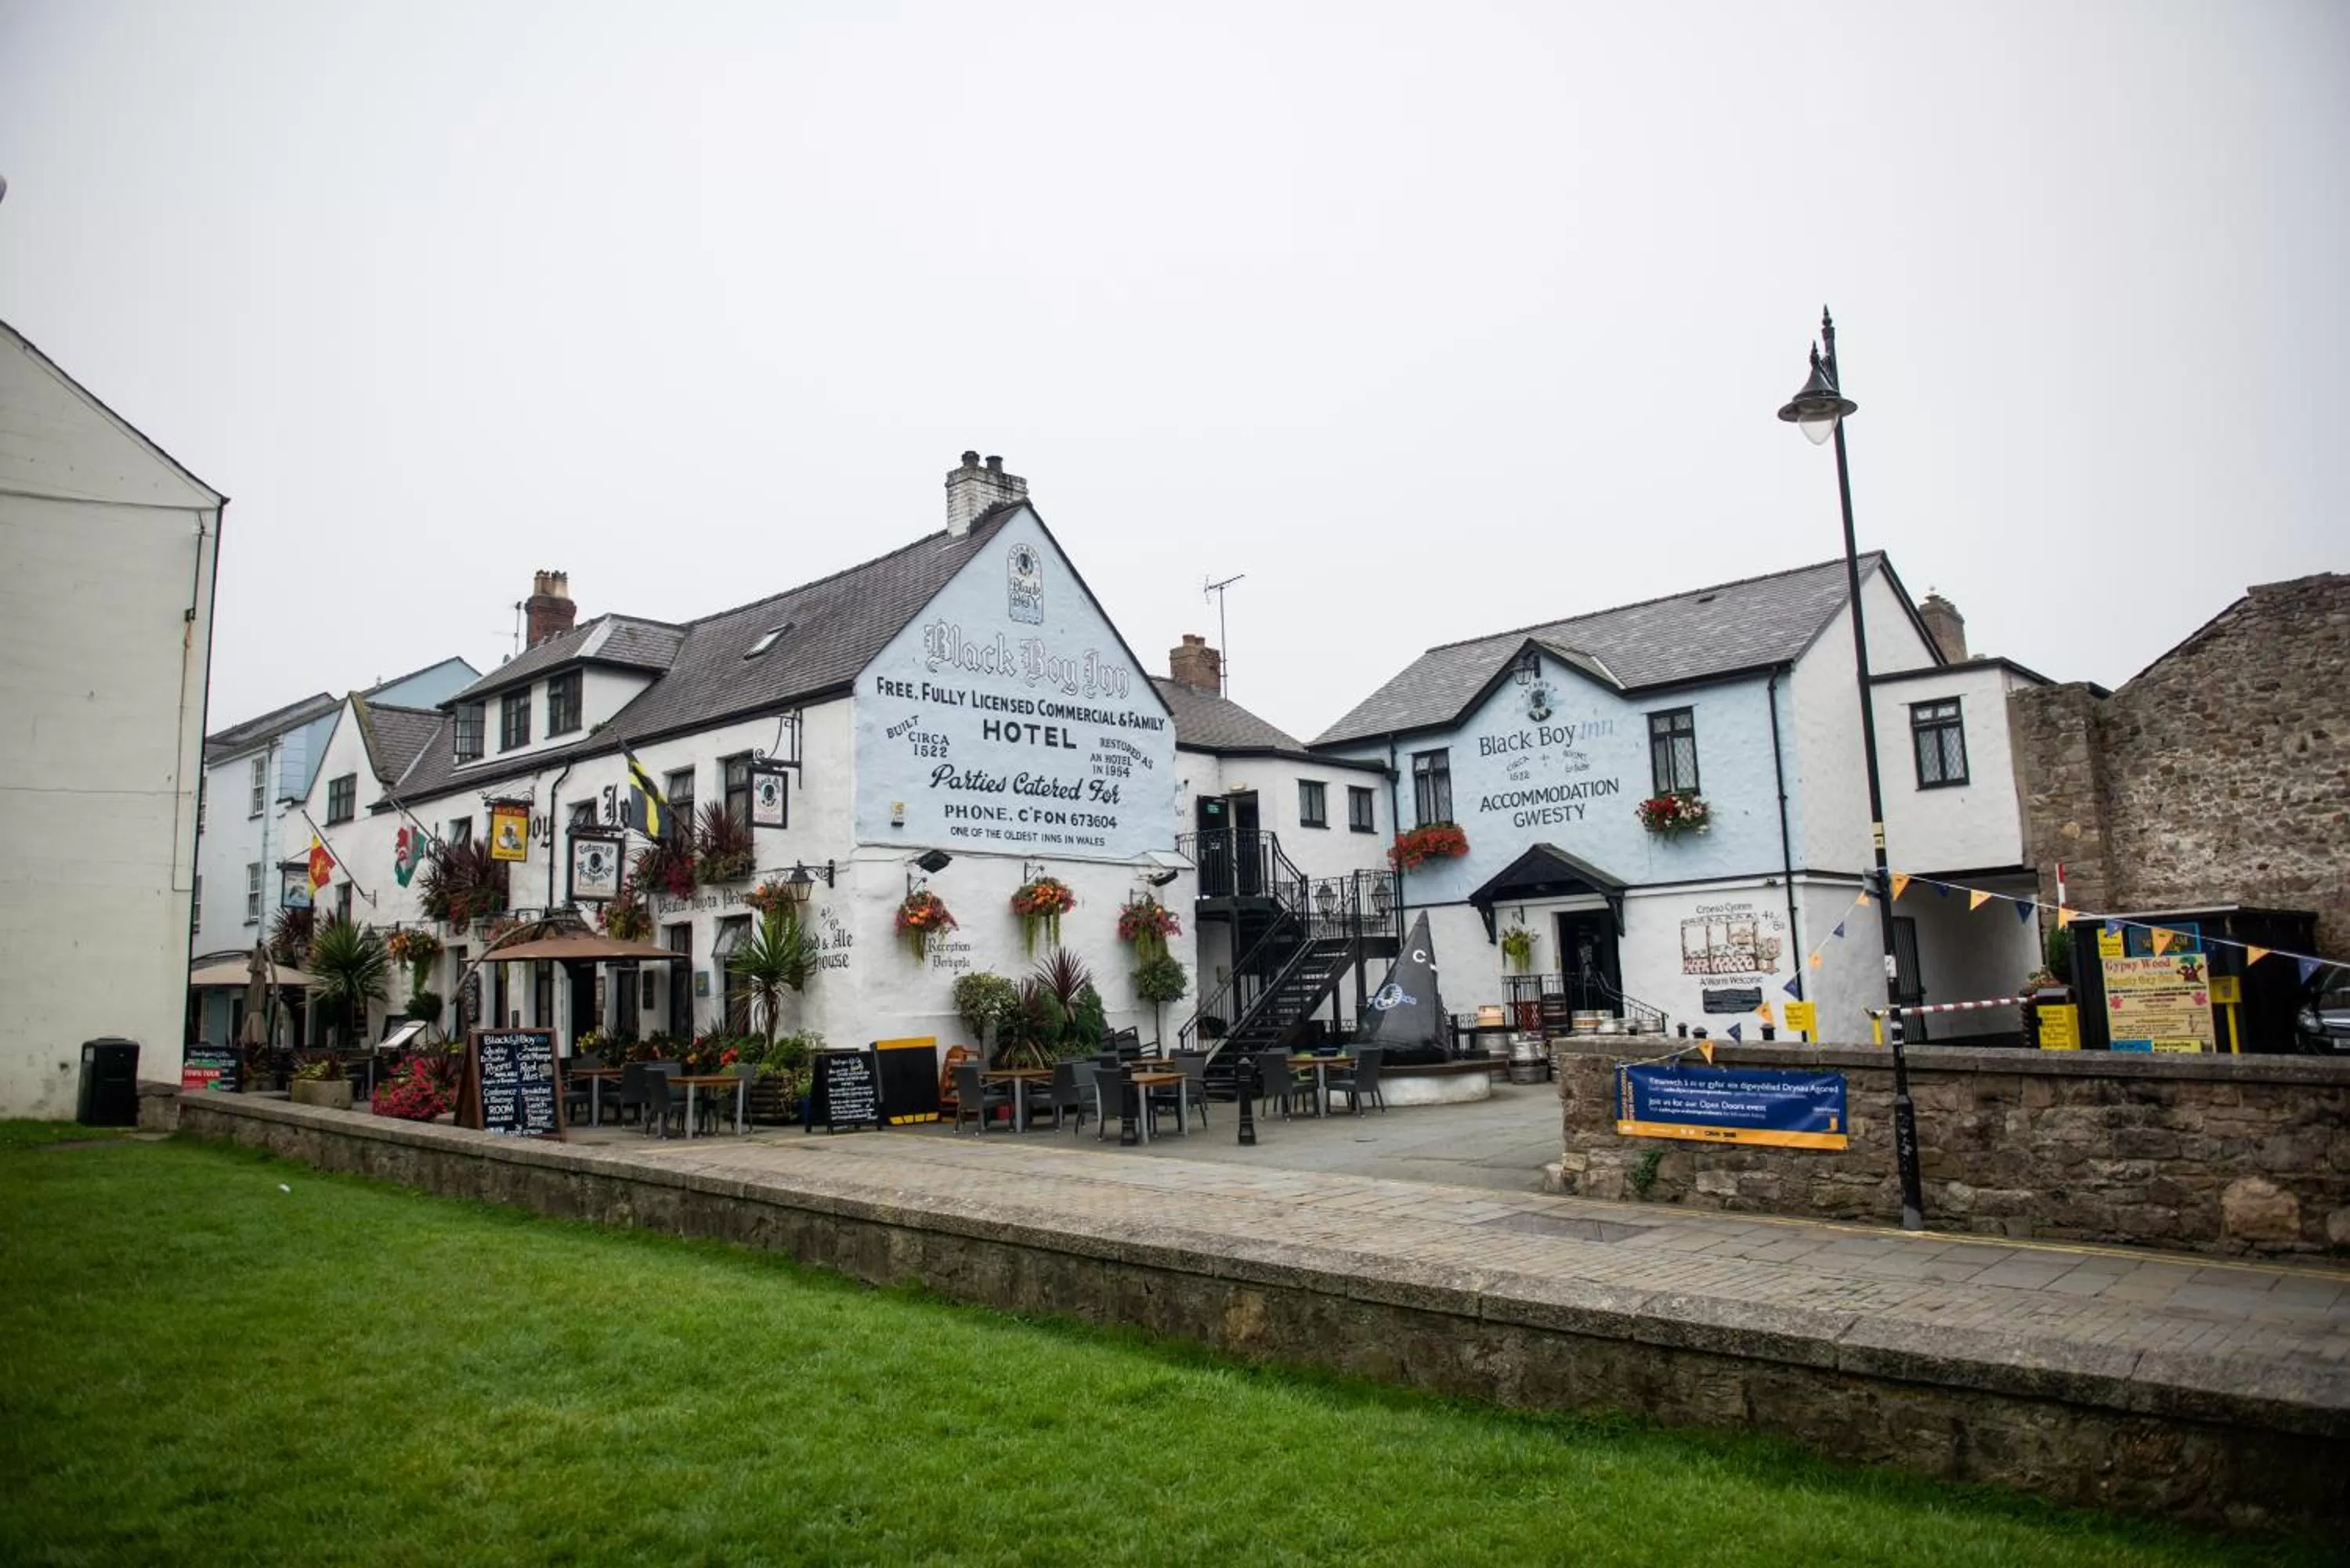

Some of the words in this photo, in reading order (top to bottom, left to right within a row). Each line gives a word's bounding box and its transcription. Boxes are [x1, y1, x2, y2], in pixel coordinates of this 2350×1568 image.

[924, 618, 1016, 676] Black
[1020, 638, 1078, 696] Boy
[1084, 649, 1129, 699] Inn
[923, 683, 966, 706] FULLY
[972, 690, 1034, 714] LICENSED
[1038, 699, 1115, 726] COMMERCIAL
[1119, 714, 1126, 727] &
[1128, 711, 1165, 731] FAMILY
[887, 715, 919, 739] BUILT
[983, 719, 1077, 750] HOTEL
[908, 732, 950, 746] CIRCA
[1479, 730, 1535, 757] Black
[1538, 724, 1576, 747] Boy
[914, 744, 948, 758] 1522
[1090, 753, 1102, 763] AN
[1105, 754, 1133, 768] HOTEL
[1100, 738, 1141, 761] RESTORED
[1141, 757, 1153, 770] AS
[1093, 764, 1103, 775] IN
[930, 764, 1007, 793] Parties
[1013, 772, 1083, 800] Catered
[1088, 779, 1120, 805] For
[1479, 777, 1620, 812] ACCOMMODATION
[1071, 813, 1118, 829] 673604
[1513, 803, 1585, 828] GWESTY
[529, 815, 551, 848] oy
[950, 826, 969, 836] ONE
[971, 827, 983, 837] OF
[985, 829, 1001, 840] THE
[1005, 829, 1038, 841] OLDEST
[1041, 833, 1062, 844] INNS
[1065, 834, 1074, 844] IN
[1077, 835, 1105, 847] WALES
[831, 929, 852, 948] Ale
[927, 937, 971, 953] Reception
[2106, 959, 2137, 973] Gypsy
[2141, 957, 2171, 968] Wood
[483, 1035, 508, 1045] Black
[488, 1104, 515, 1115] ROOM
[1699, 1100, 1719, 1109] Open
